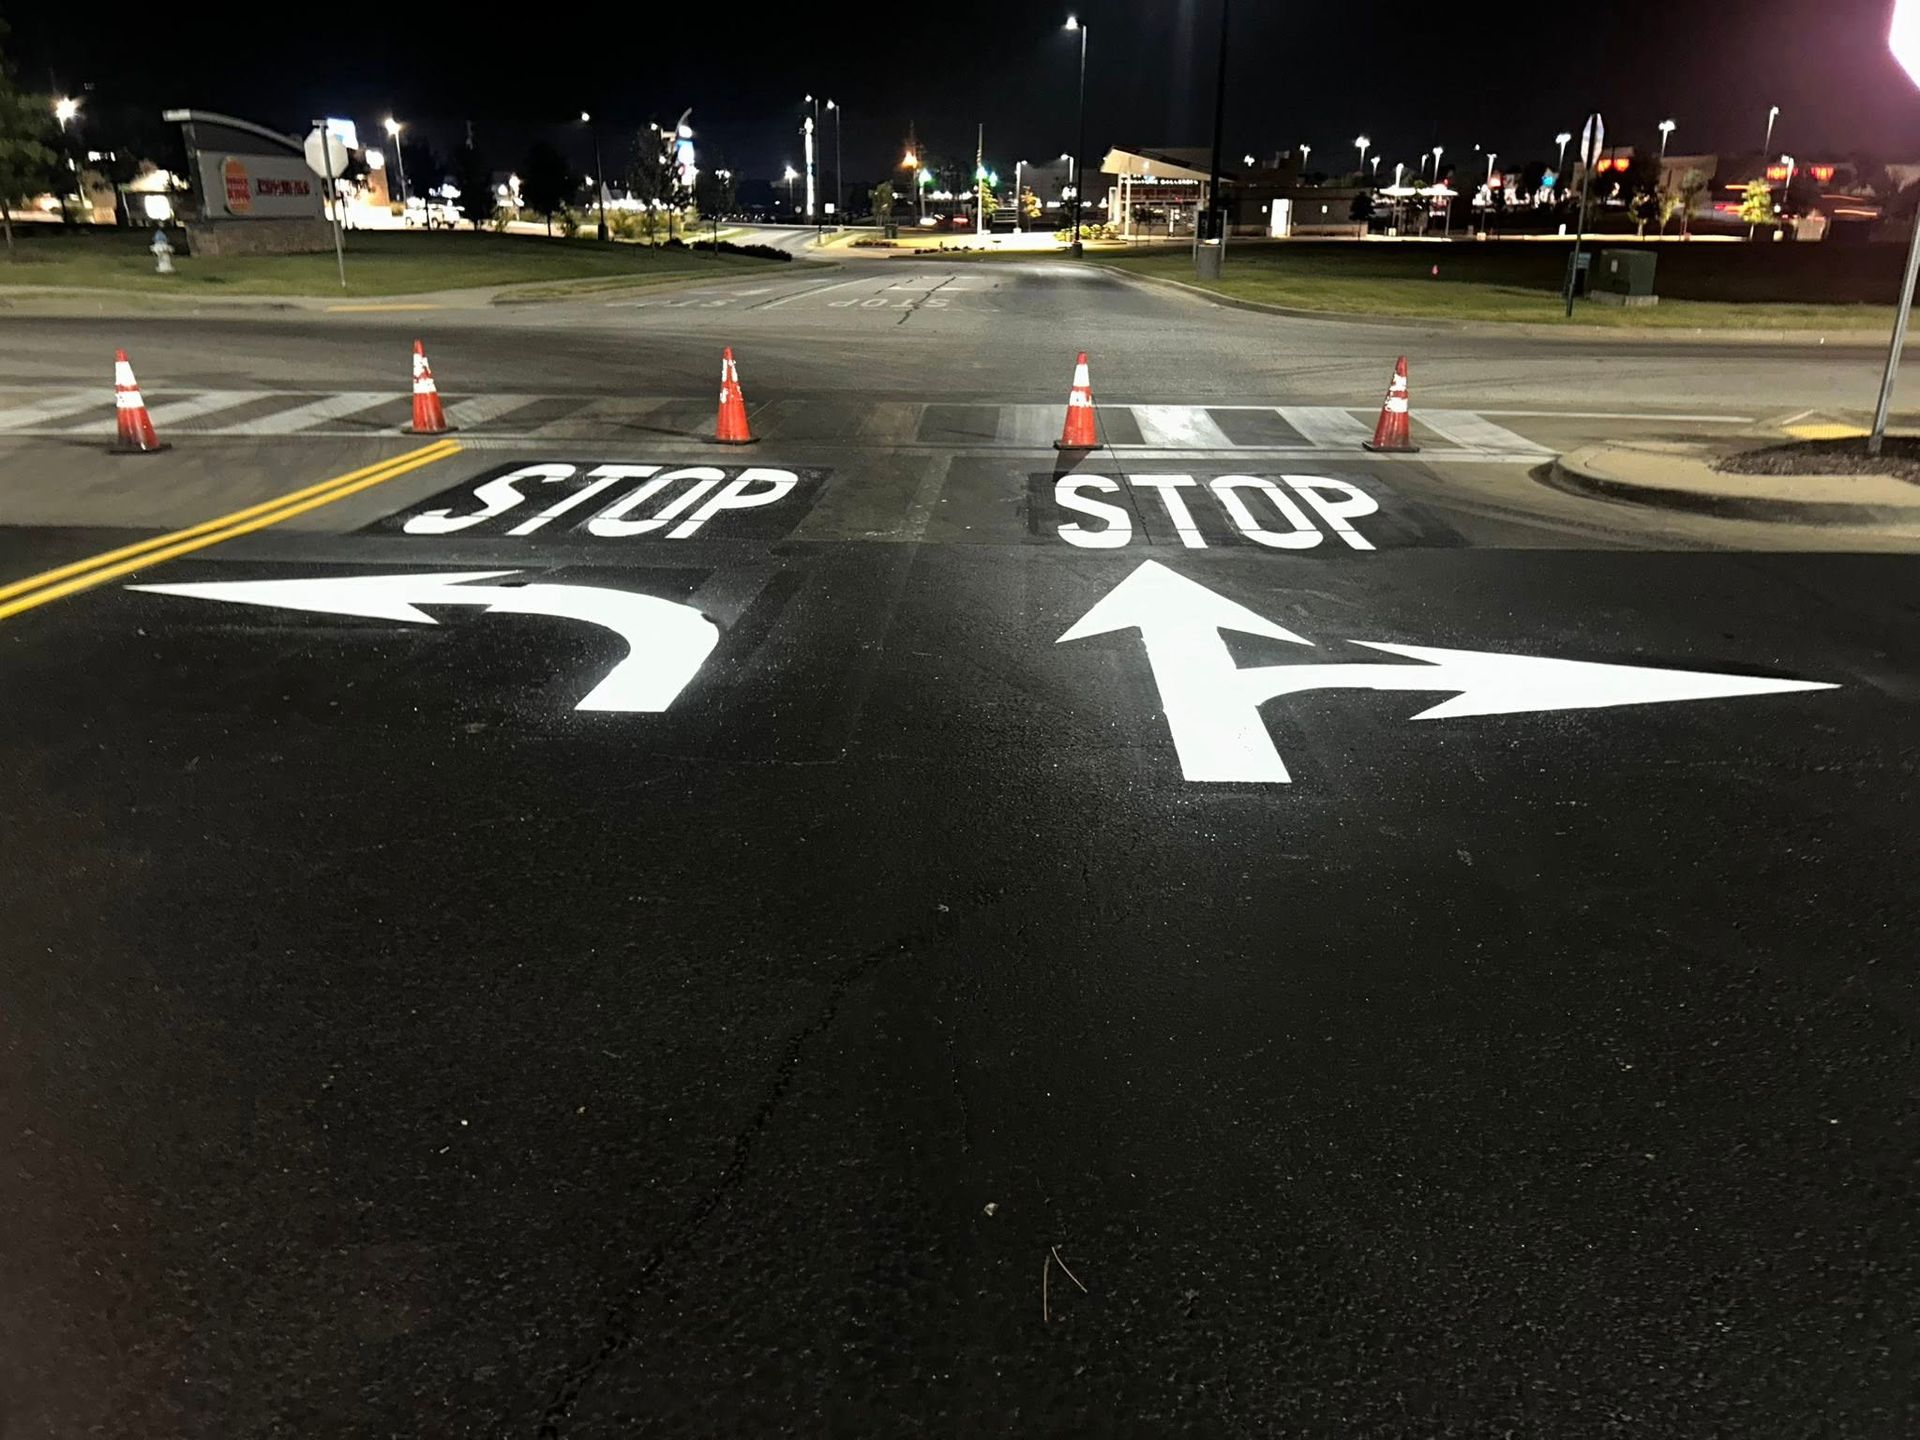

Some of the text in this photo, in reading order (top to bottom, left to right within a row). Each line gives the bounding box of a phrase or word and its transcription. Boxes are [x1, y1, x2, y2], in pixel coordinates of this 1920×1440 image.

[827, 298, 950, 308] STOP
[403, 464, 799, 539] STOP
[1054, 474, 1379, 550] STOP
